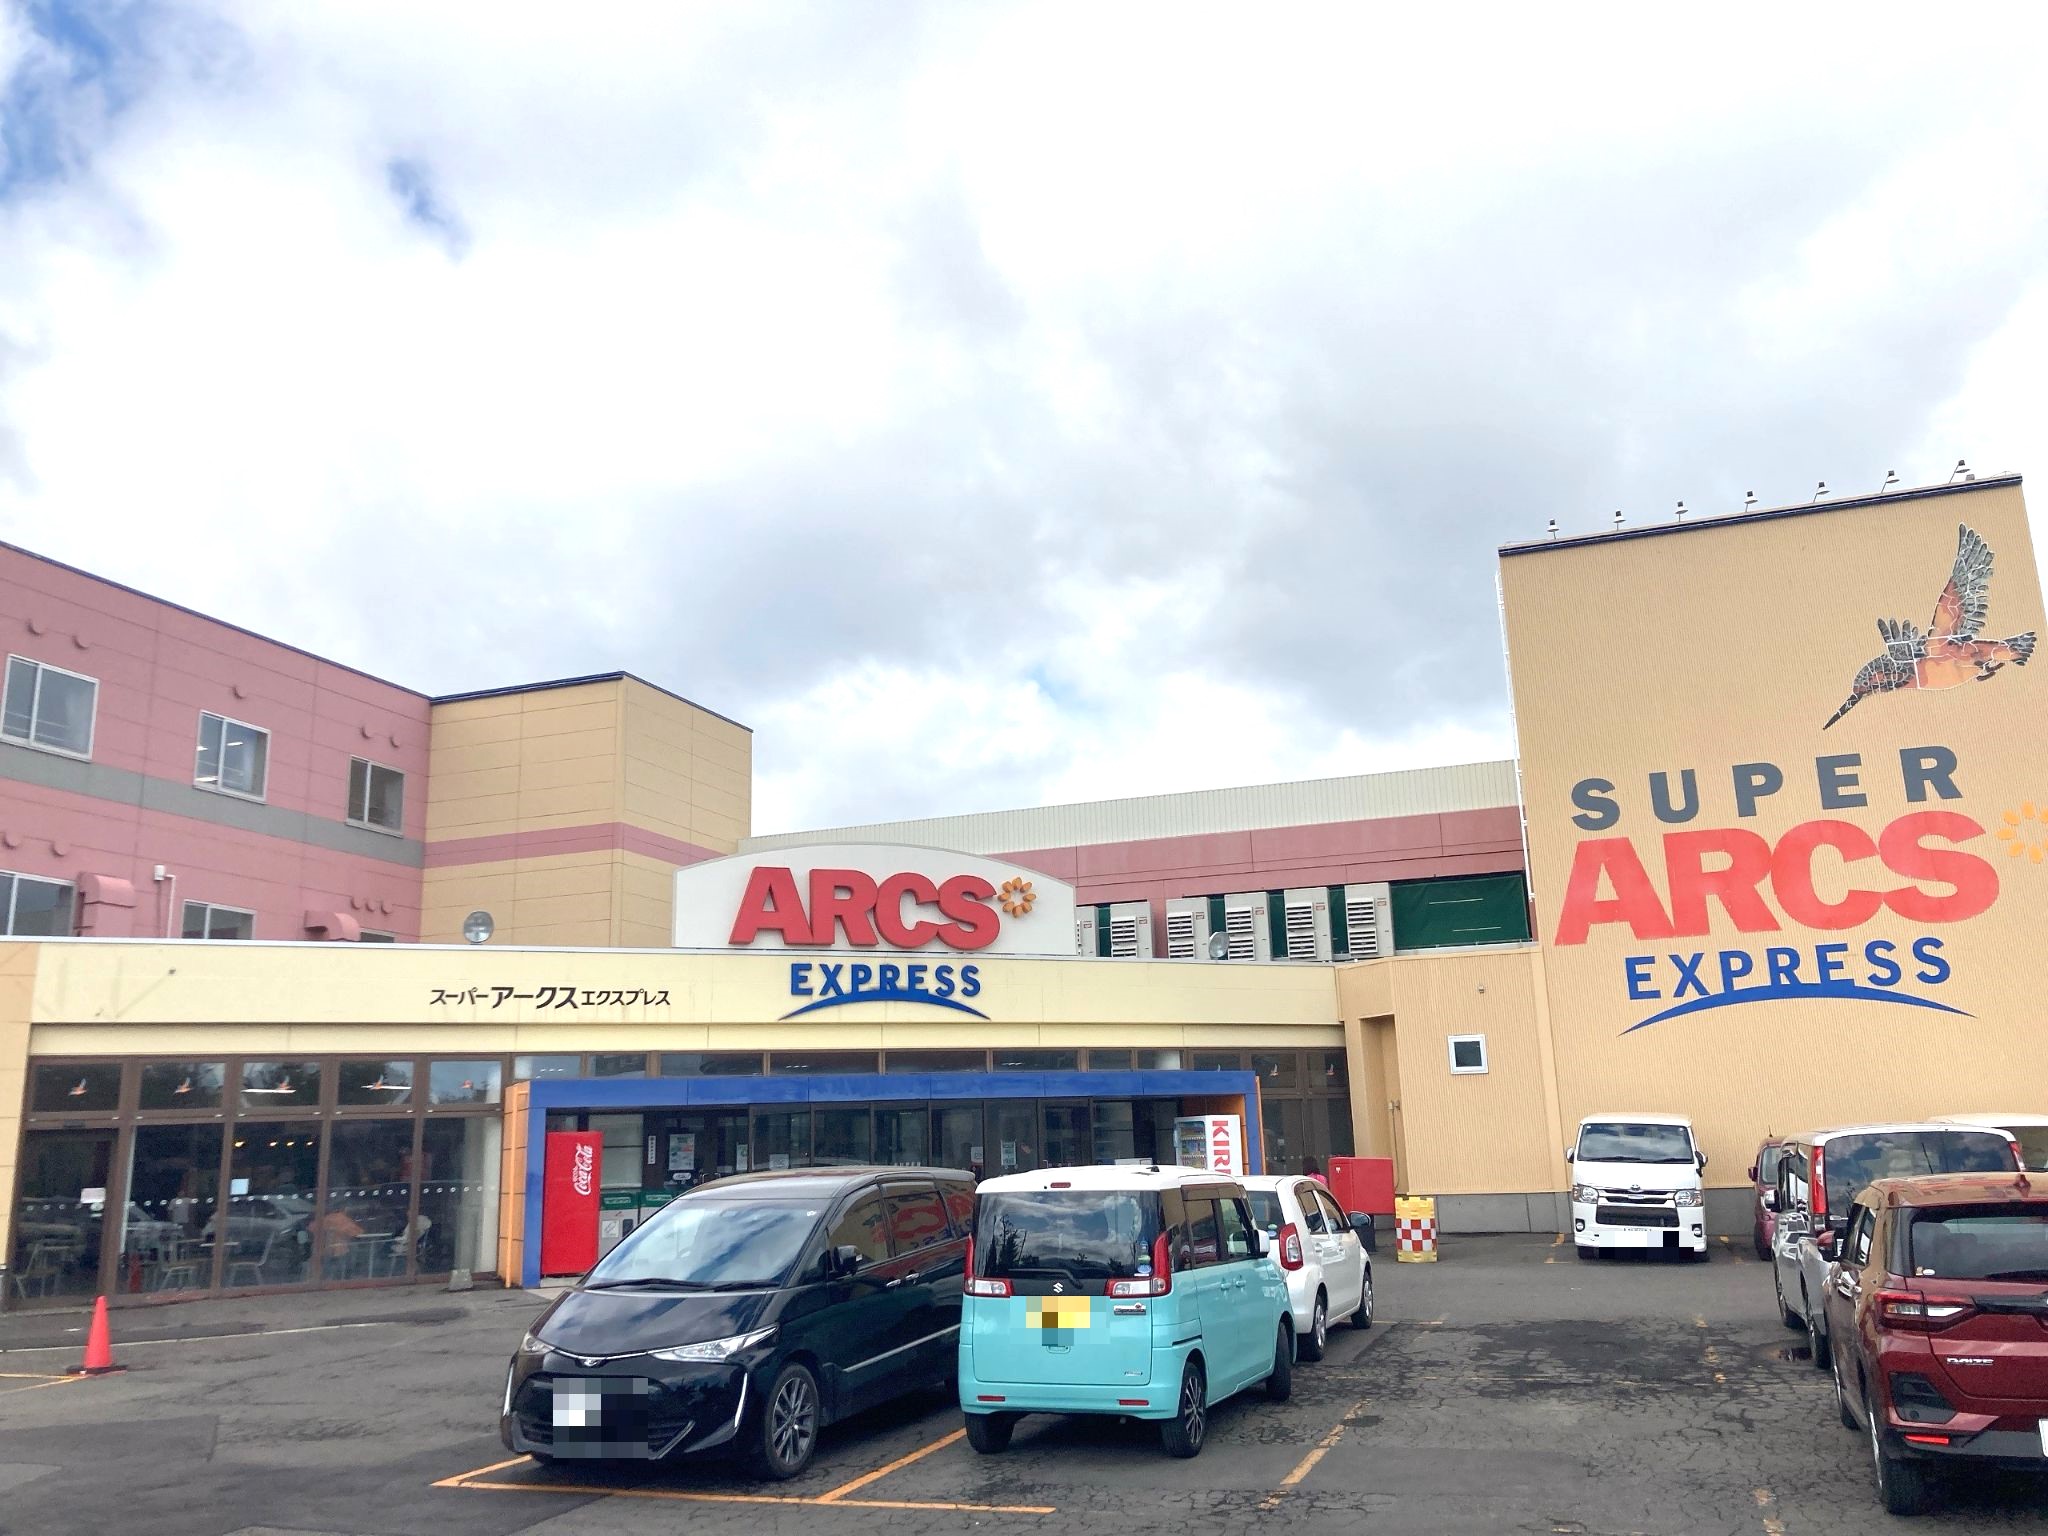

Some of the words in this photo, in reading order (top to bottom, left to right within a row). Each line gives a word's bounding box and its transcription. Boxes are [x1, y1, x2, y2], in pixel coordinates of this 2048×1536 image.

[1571, 745, 1963, 831] SUPER
[729, 866, 1001, 950] ARCS
[1554, 810, 2000, 946] ARCS
[790, 963, 981, 998] EXPRESS
[1625, 937, 1951, 1001] EXPRESS
